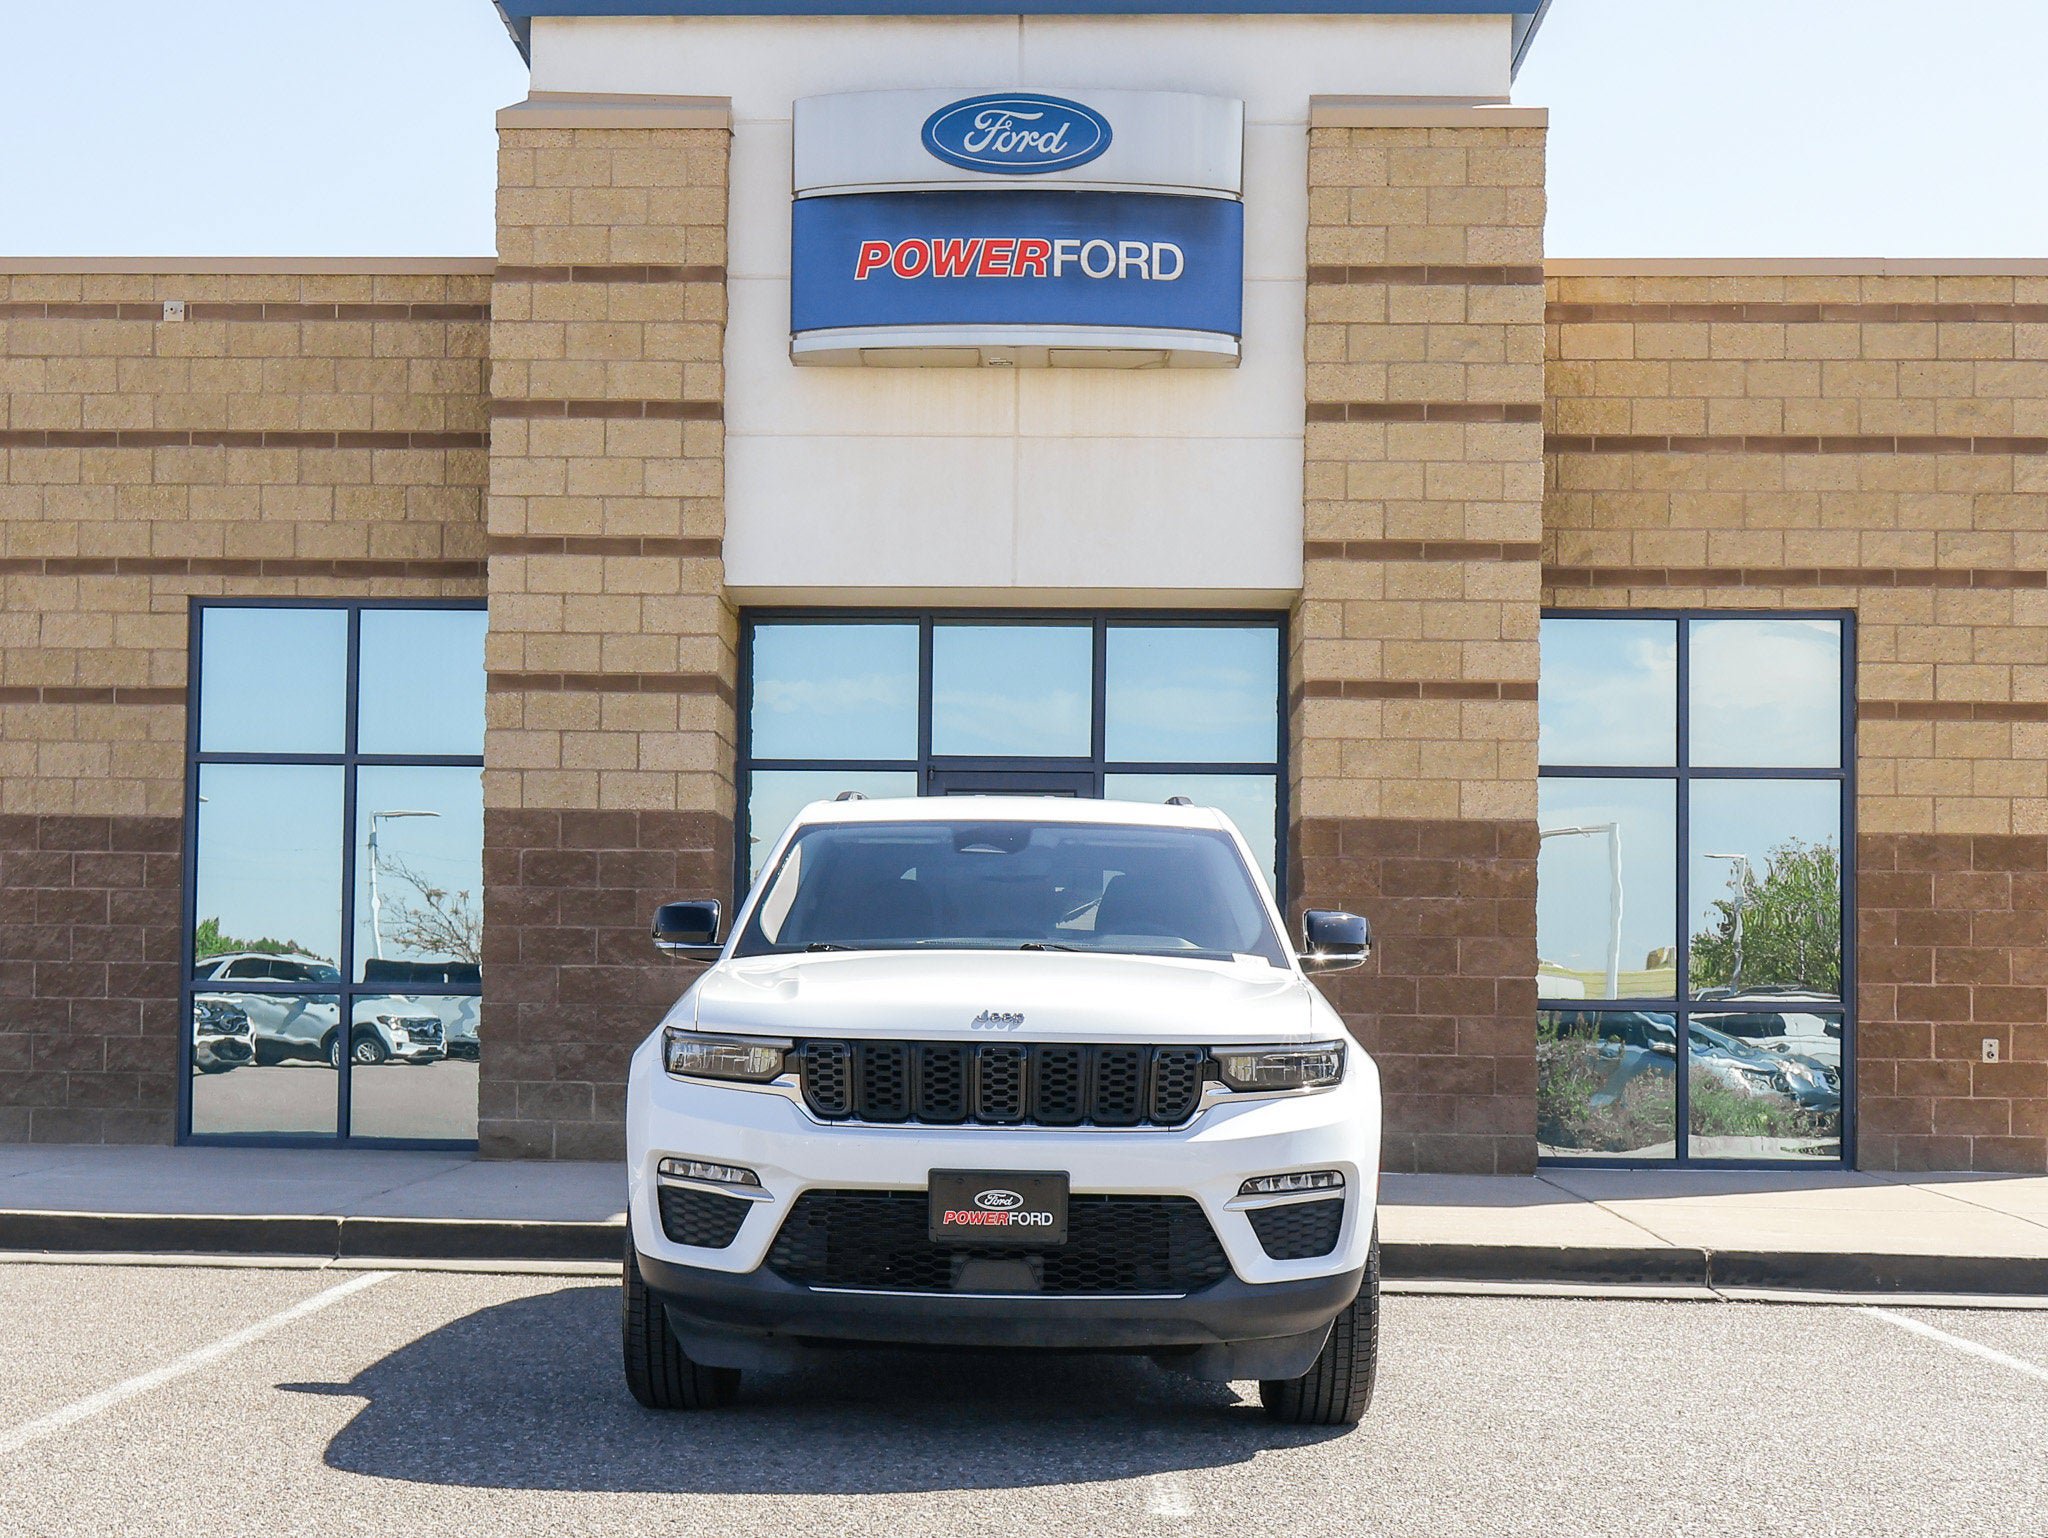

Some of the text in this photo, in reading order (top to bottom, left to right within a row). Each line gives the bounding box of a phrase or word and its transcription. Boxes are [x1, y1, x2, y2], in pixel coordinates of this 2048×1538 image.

[963, 109, 1070, 153] Ford
[973, 1009, 1025, 1026] Jeep
[984, 1194, 1013, 1206] Ford
